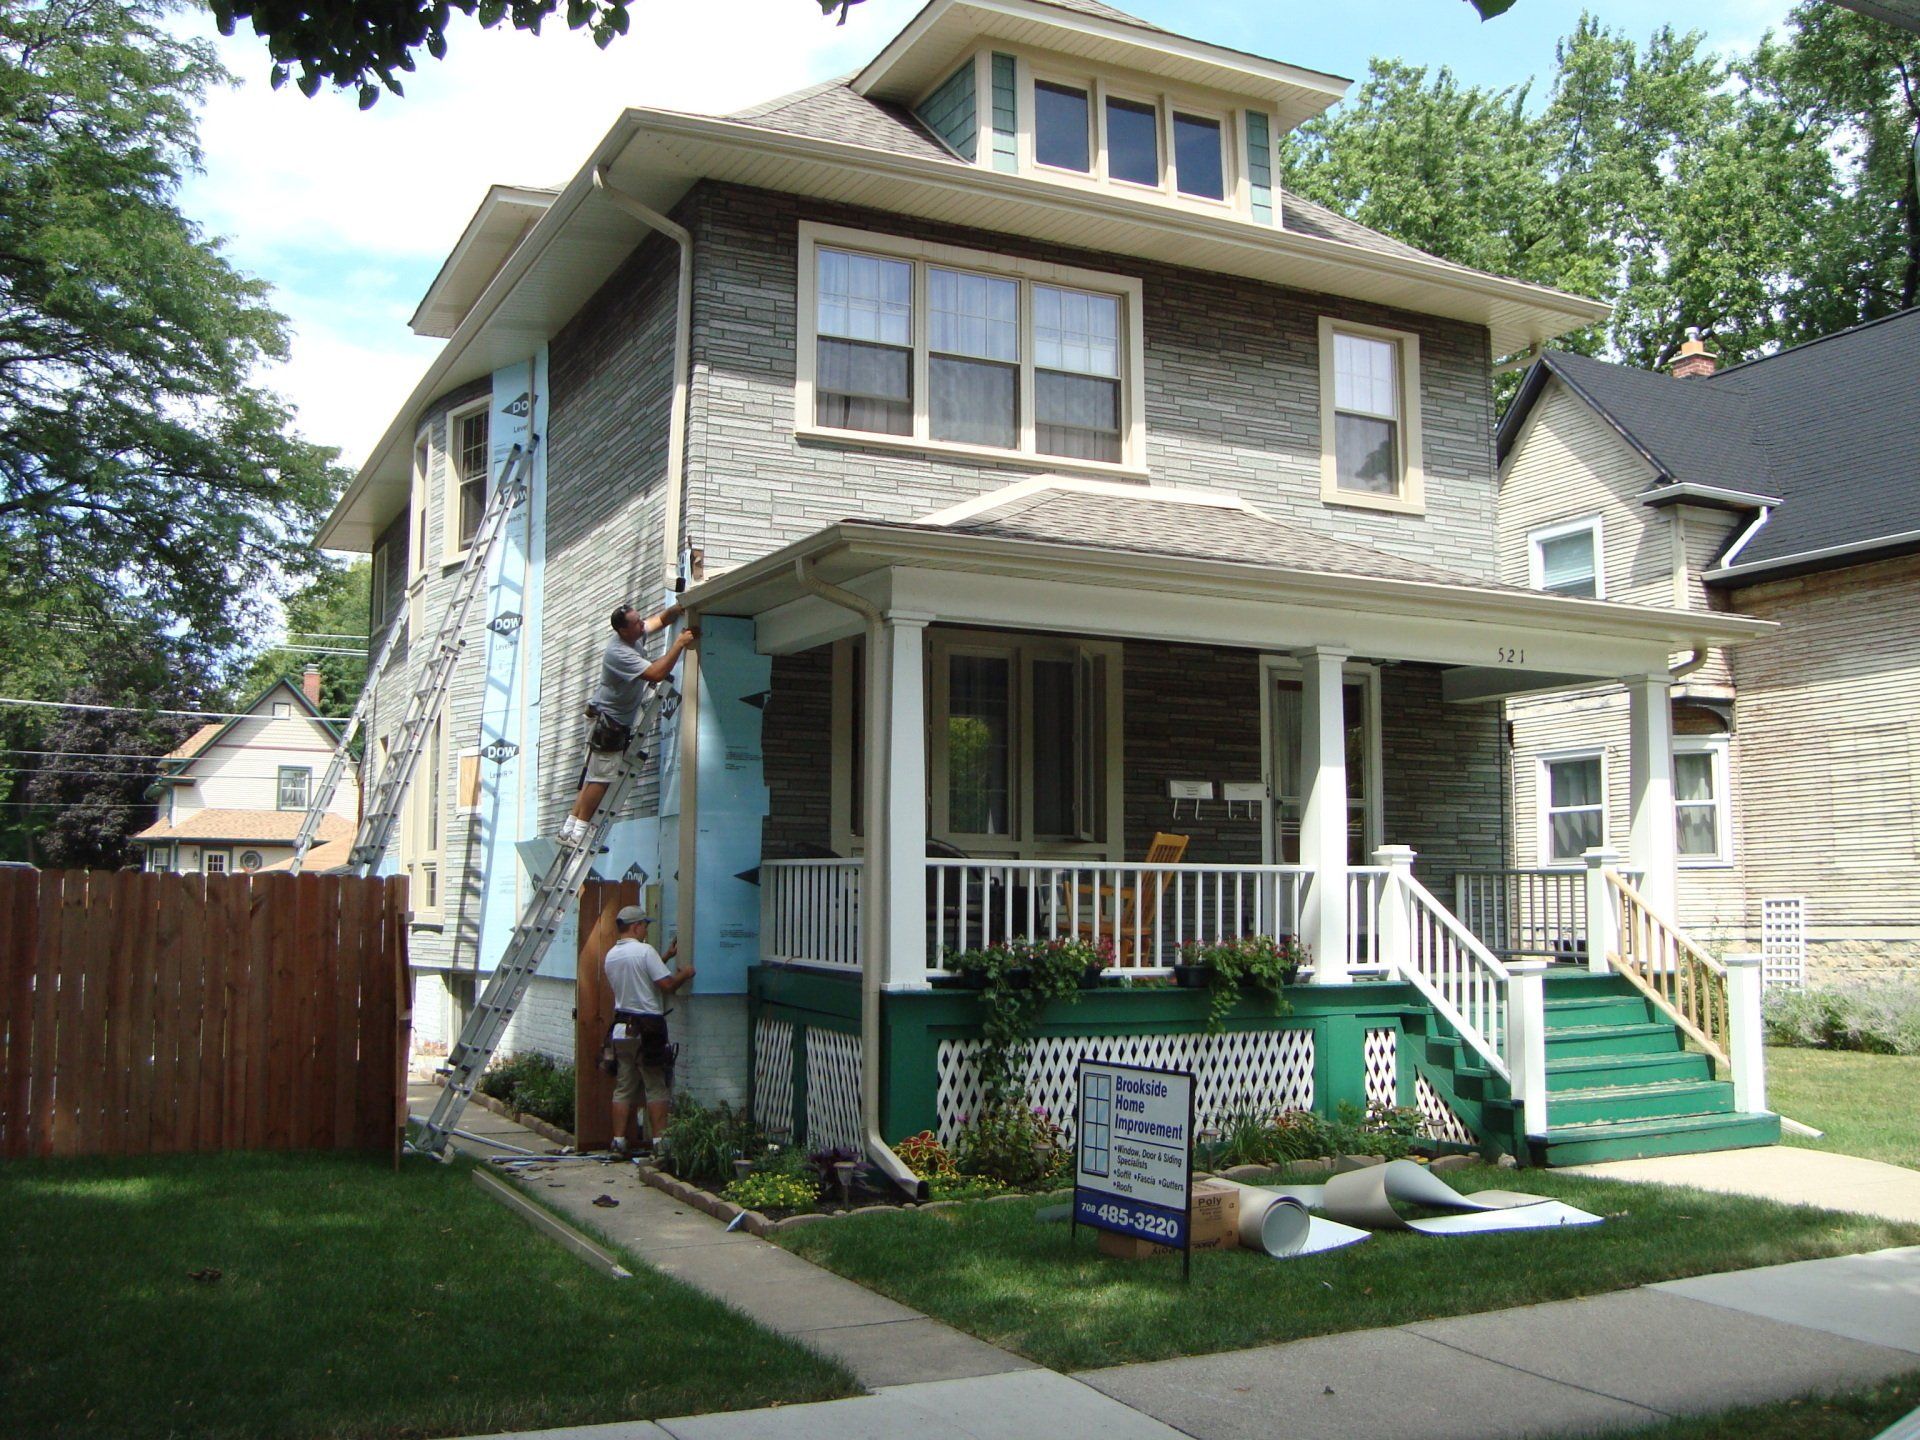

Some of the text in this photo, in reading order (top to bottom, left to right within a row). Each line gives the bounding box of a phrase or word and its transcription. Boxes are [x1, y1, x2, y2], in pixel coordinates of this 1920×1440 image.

[1498, 647, 1524, 664] 521
[1116, 1075, 1167, 1098] Brookside
[1115, 1094, 1145, 1113] Home
[1115, 1113, 1183, 1140] Improvement
[1117, 1155, 1148, 1169] Specialists
[1142, 1149, 1157, 1160] Door
[1158, 1152, 1162, 1162] &
[1163, 1153, 1182, 1168] Siding
[1198, 1196, 1222, 1207] Poly
[1081, 1202, 1097, 1214] 708
[1098, 1203, 1178, 1239] 485-3220
